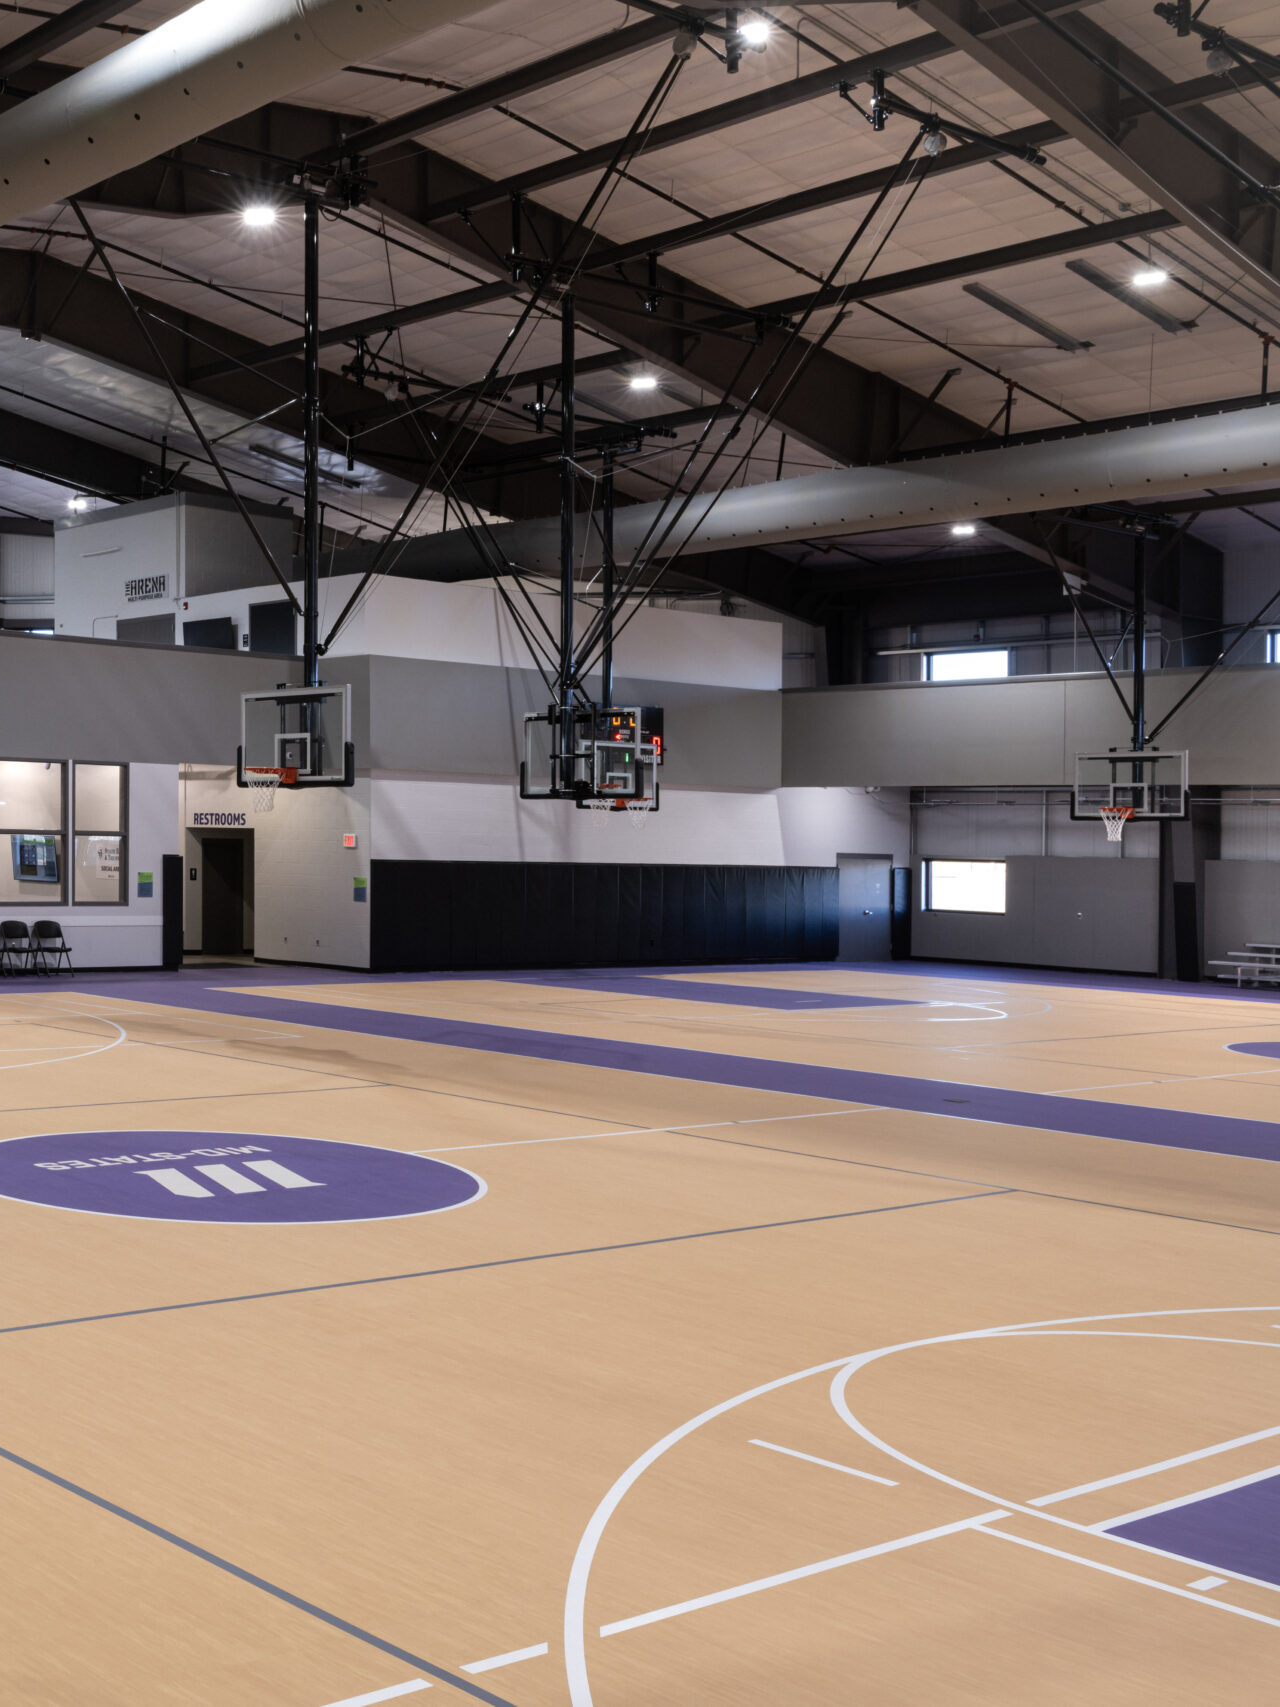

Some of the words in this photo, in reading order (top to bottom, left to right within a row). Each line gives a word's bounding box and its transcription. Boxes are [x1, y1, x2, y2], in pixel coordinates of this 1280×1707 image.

[131, 575, 166, 597] ARENA
[193, 812, 247, 826] RESTROOMS
[34, 1145, 272, 1170] MID-STATES
